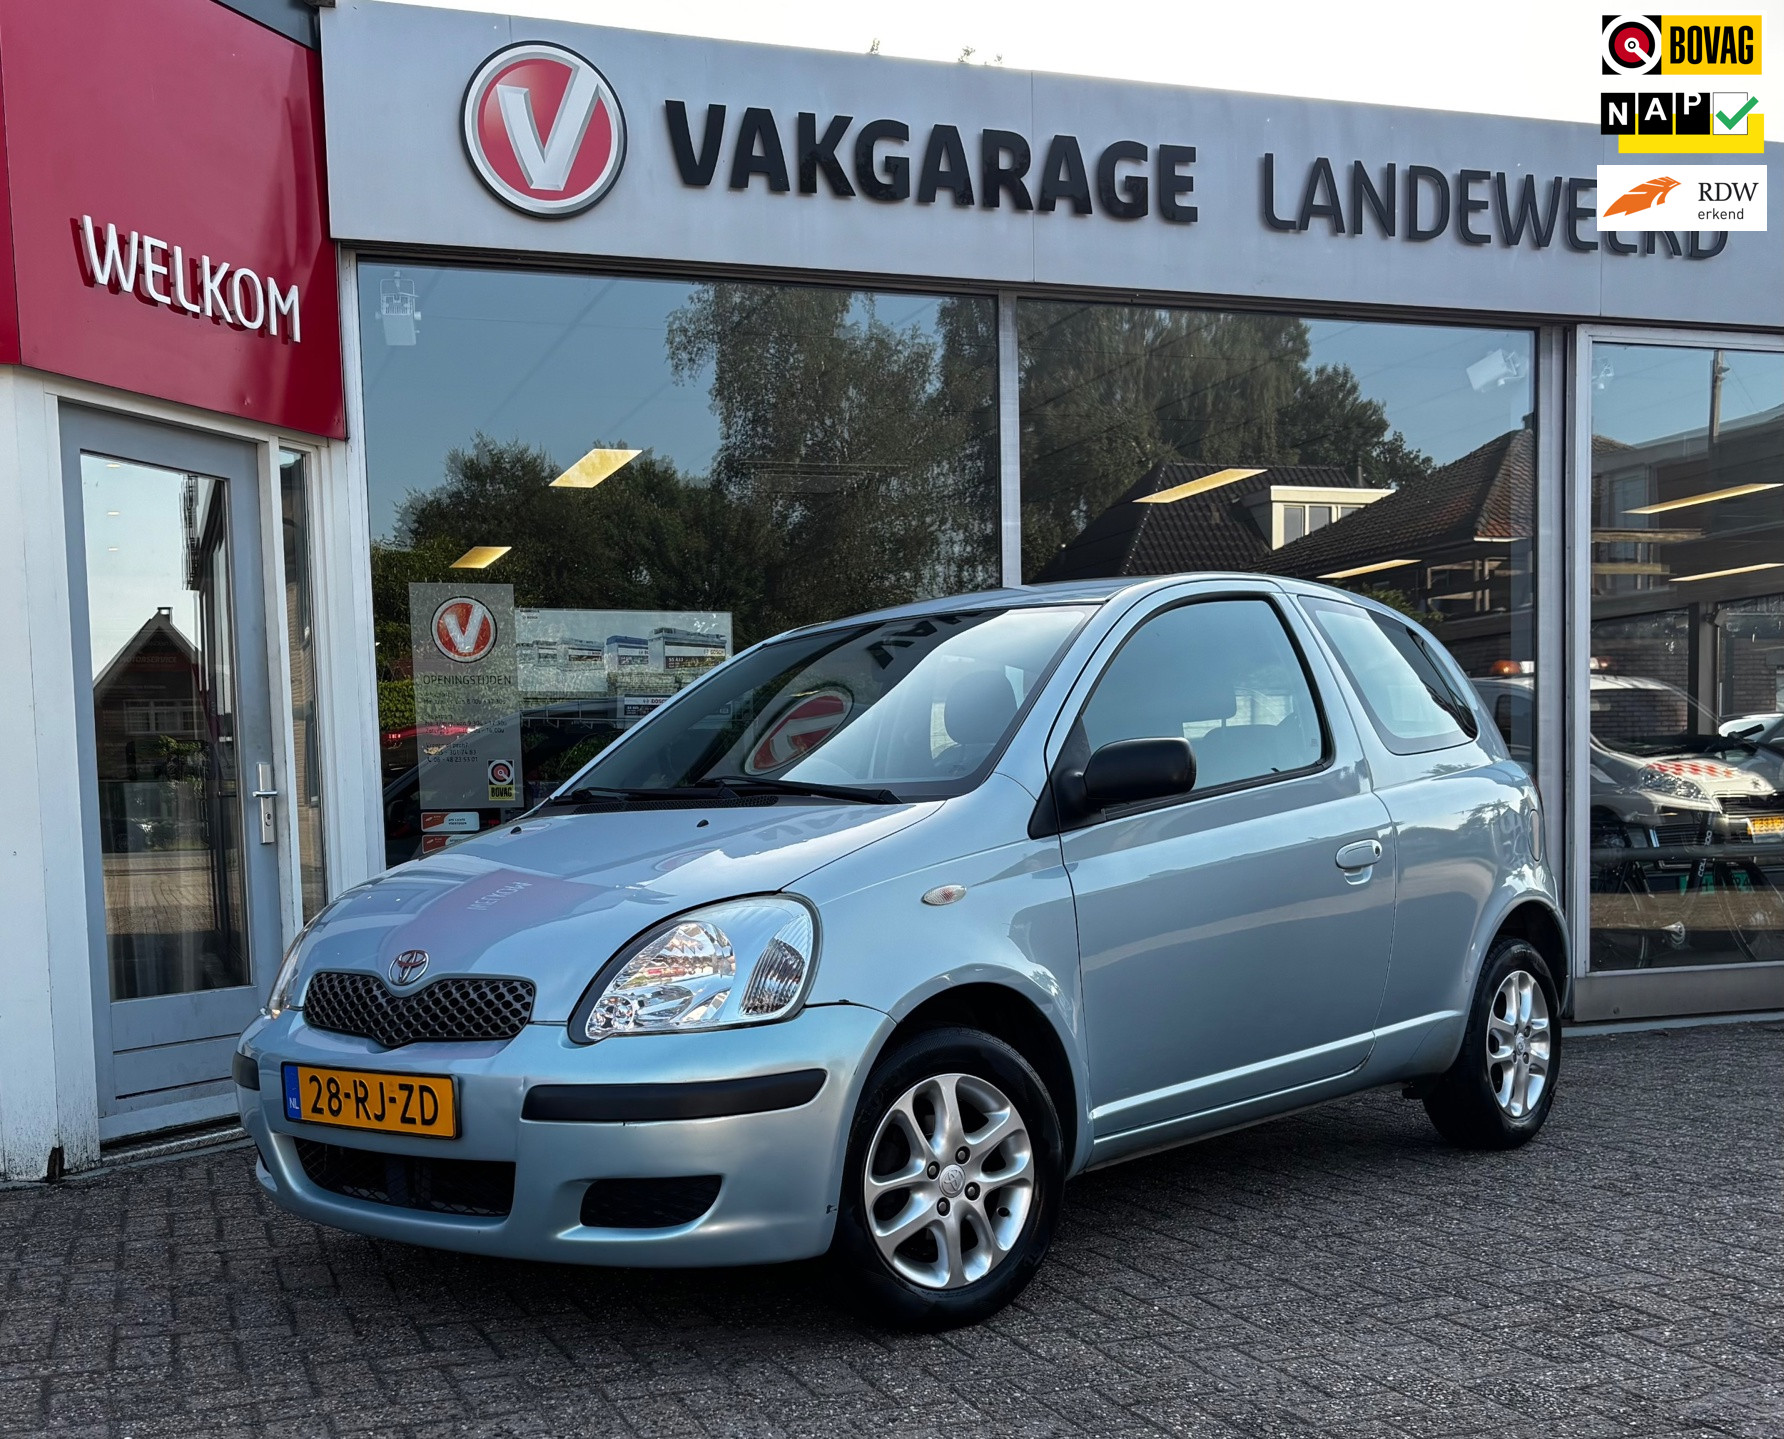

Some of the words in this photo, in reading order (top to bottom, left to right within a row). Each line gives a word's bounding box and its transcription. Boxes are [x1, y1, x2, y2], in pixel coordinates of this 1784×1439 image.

[664, 99, 1199, 224] VAKGARAGE
[1263, 152, 1729, 260] LANDEWE
[81, 213, 301, 344] WELKOM
[423, 674, 512, 685] OPENINGSTIJDEN
[490, 786, 512, 798] BOVAG
[288, 1096, 300, 1110] NL
[308, 1073, 440, 1126] 28-RJ-ZD
